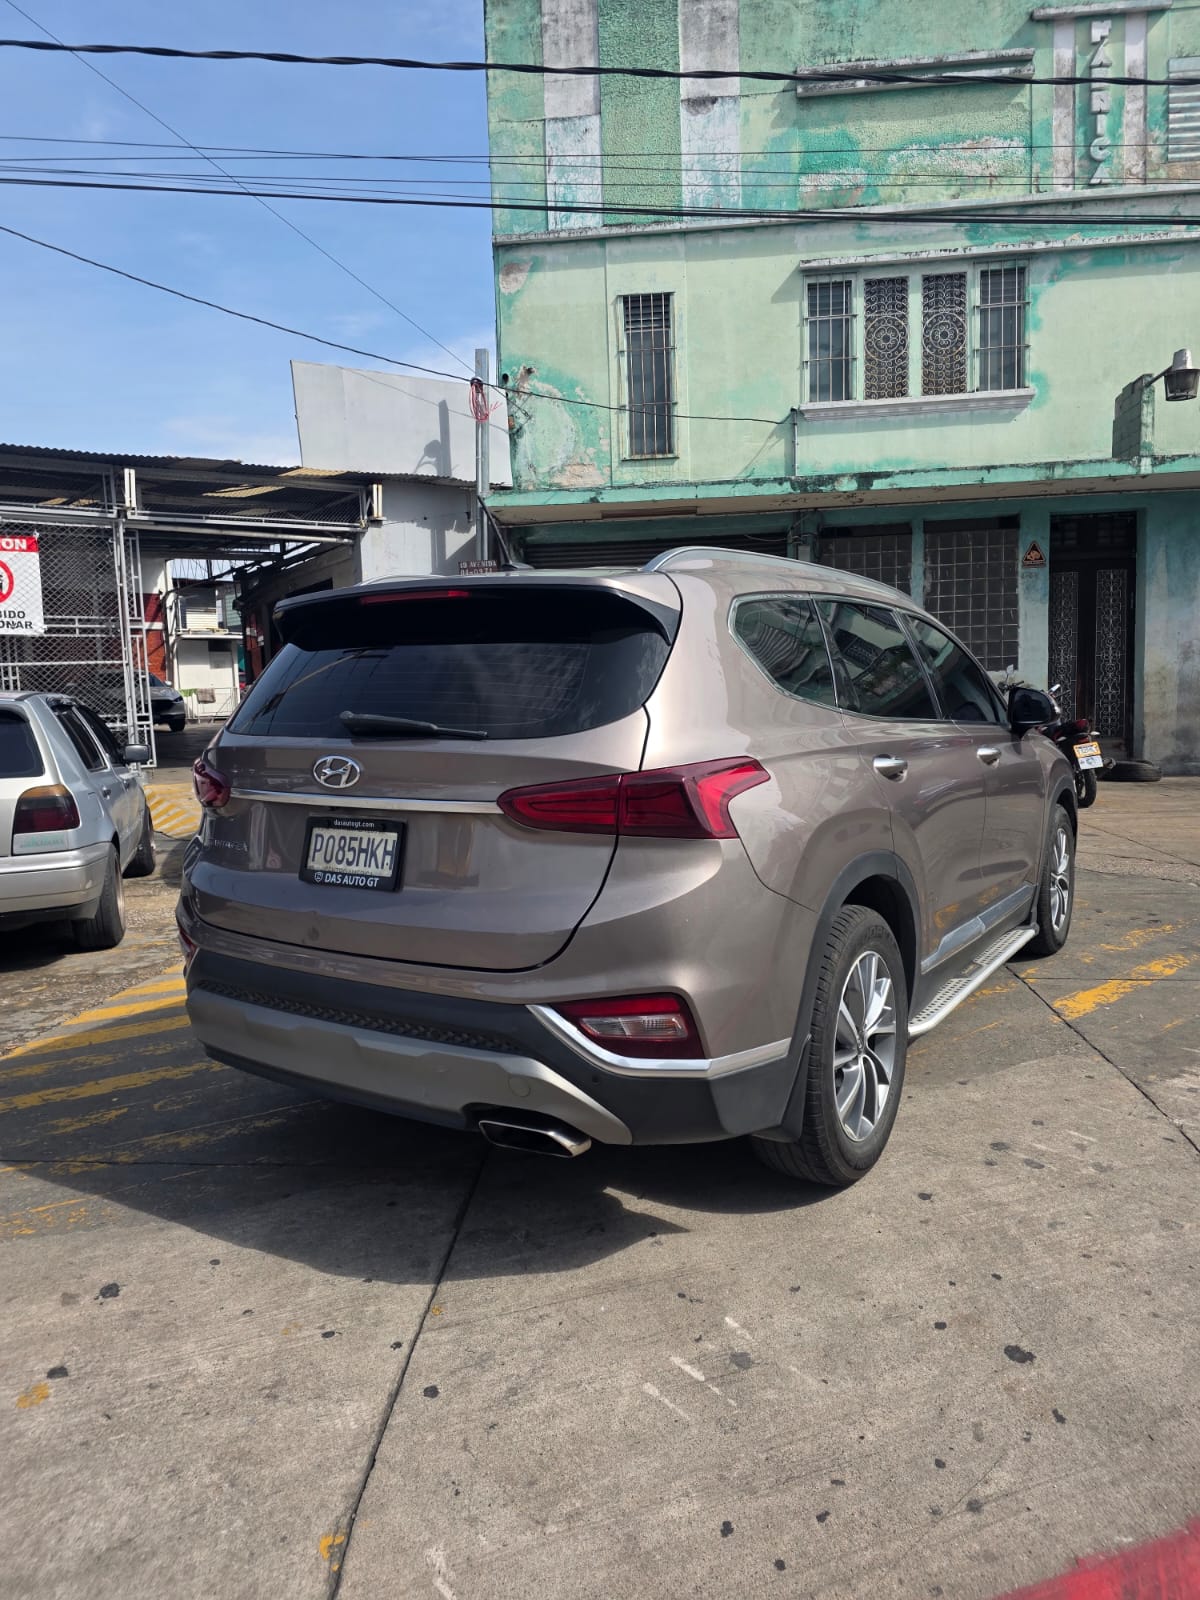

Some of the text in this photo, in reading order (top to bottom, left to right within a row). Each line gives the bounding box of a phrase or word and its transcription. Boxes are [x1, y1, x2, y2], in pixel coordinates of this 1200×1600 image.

[334, 819, 375, 828] dasautogt.com
[311, 833, 396, 871] P085HKH
[324, 873, 379, 887] DAS AUTO GT
